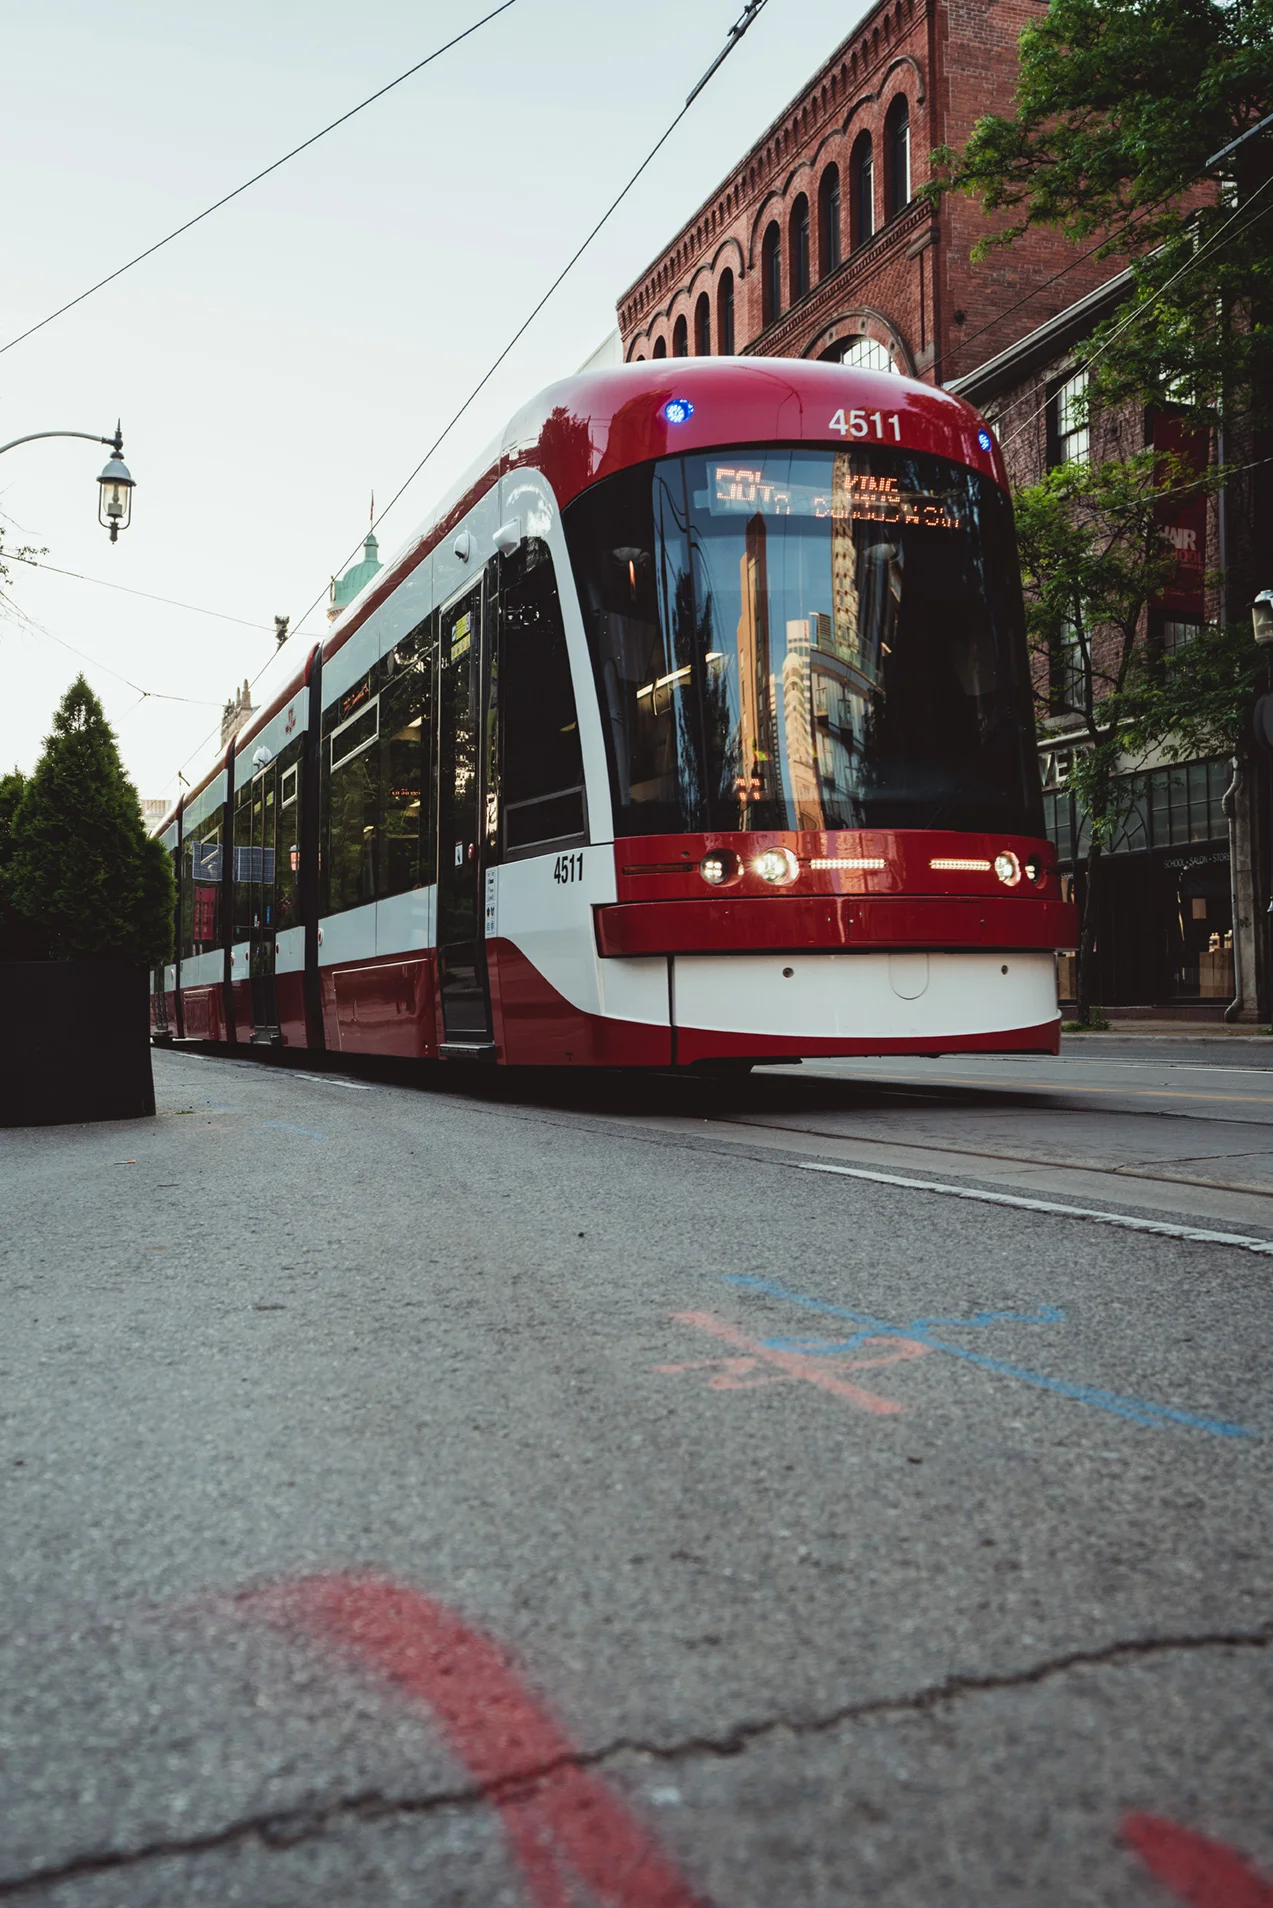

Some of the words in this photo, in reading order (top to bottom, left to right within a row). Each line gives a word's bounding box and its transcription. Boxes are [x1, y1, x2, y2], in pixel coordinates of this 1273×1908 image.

[829, 408, 901, 442] 4511
[554, 853, 583, 884] 4511
[1164, 858, 1185, 869] SCHOOL
[1189, 856, 1208, 866] SALON
